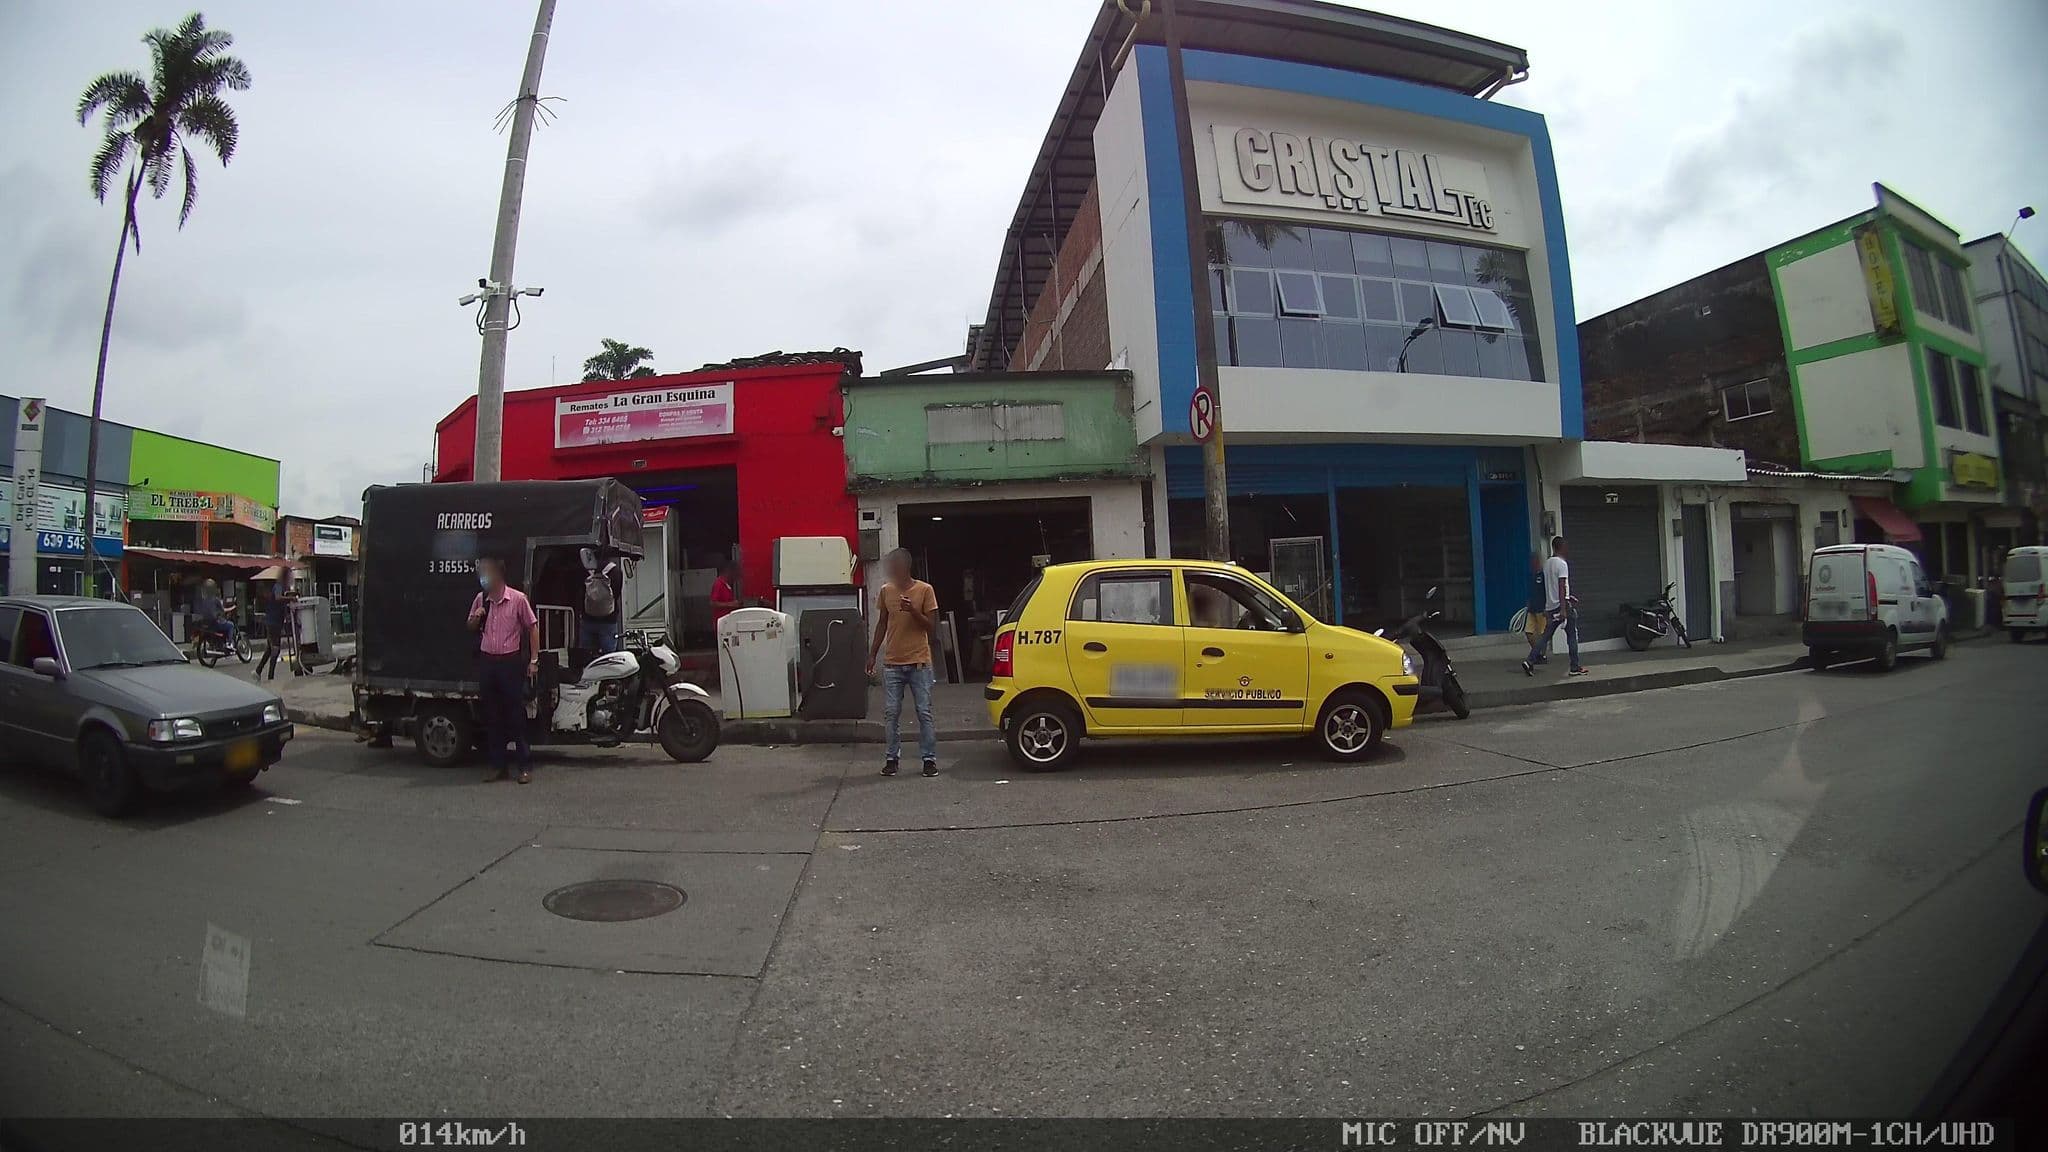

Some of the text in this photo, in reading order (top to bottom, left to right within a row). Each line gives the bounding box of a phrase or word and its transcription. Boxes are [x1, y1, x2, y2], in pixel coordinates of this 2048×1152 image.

[1235, 128, 1456, 215] CRISTAL
[570, 389, 716, 412] Remates La Gran Esquina
[27, 469, 36, 480] 14
[25, 484, 35, 498] CL
[151, 494, 166, 506] EL
[168, 496, 214, 509] TREBOL
[25, 523, 33, 531] K
[437, 512, 493, 529] ACARREOS
[43, 534, 63, 548] 639
[1018, 630, 1062, 645] H.787
[1245, 689, 1282, 700] PUBLICO
